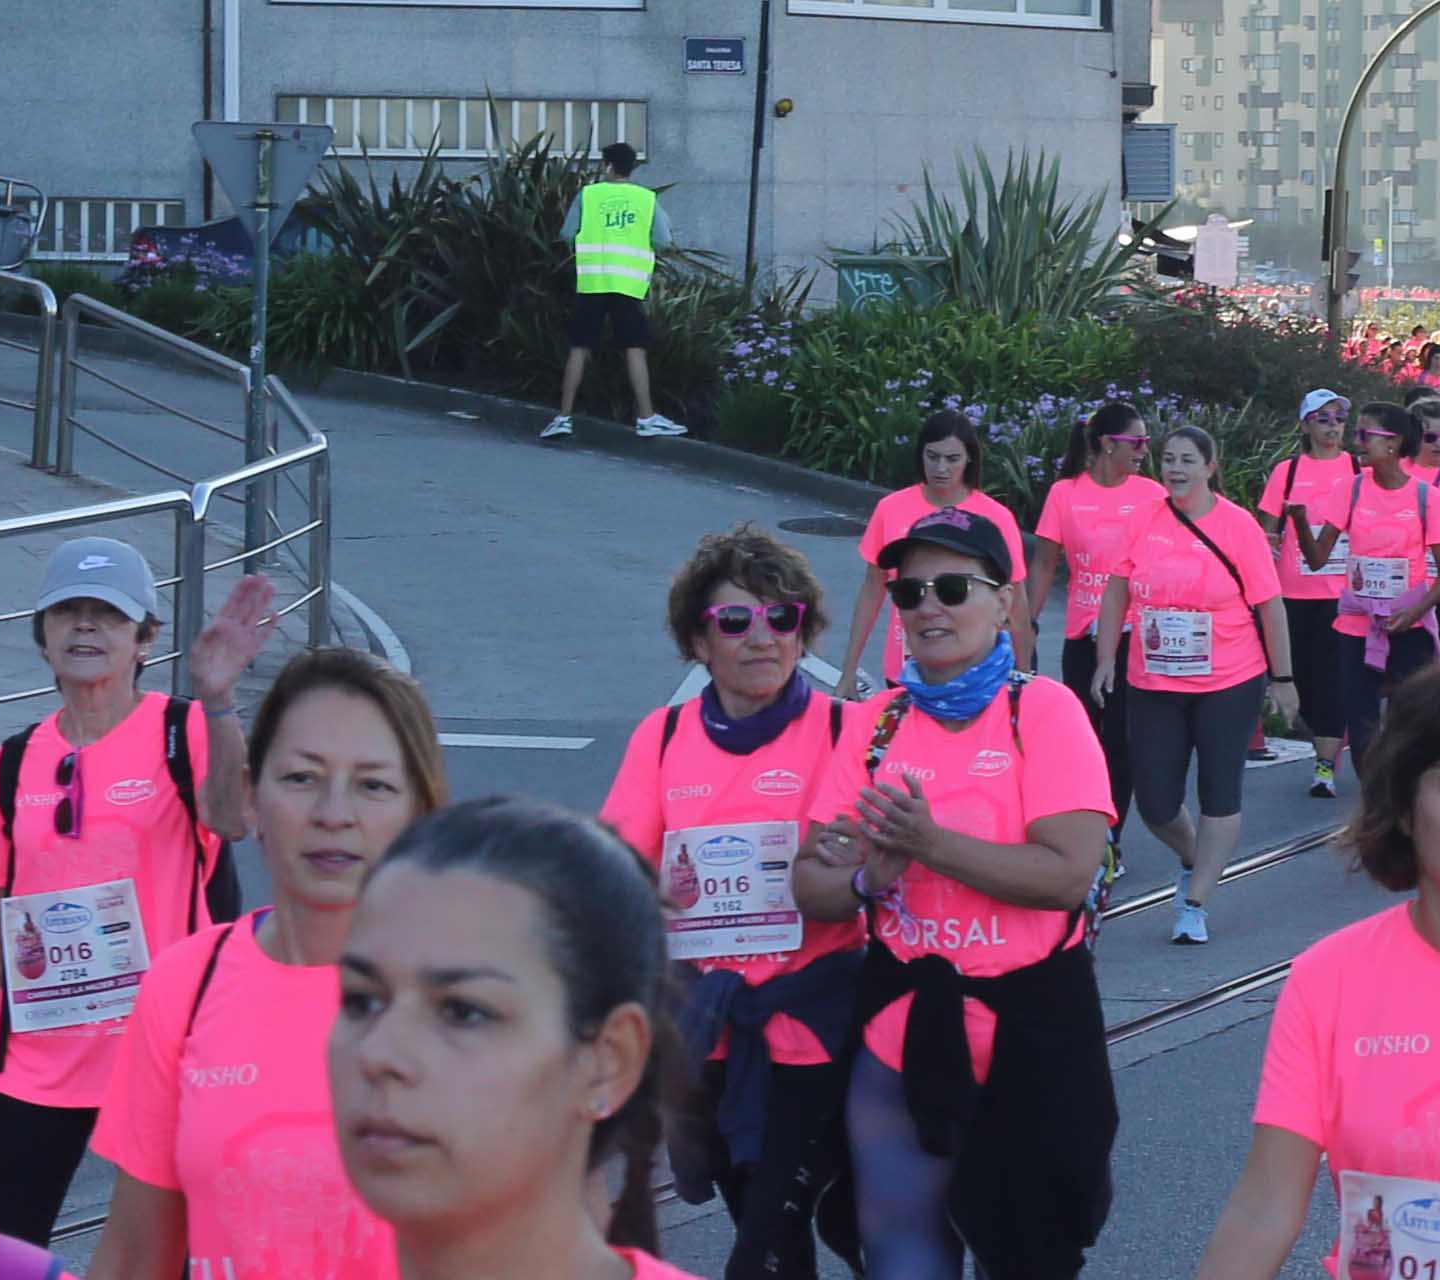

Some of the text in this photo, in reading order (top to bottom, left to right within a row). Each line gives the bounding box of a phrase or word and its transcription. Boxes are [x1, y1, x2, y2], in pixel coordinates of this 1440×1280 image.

[687, 60, 742, 71] SANTA TERESA
[605, 210, 636, 229] Life
[1364, 579, 1387, 590] 016
[1162, 636, 1187, 648] 016
[704, 875, 751, 896] 016
[49, 942, 93, 964] 016
[1354, 1033, 1430, 1057] OYSHO
